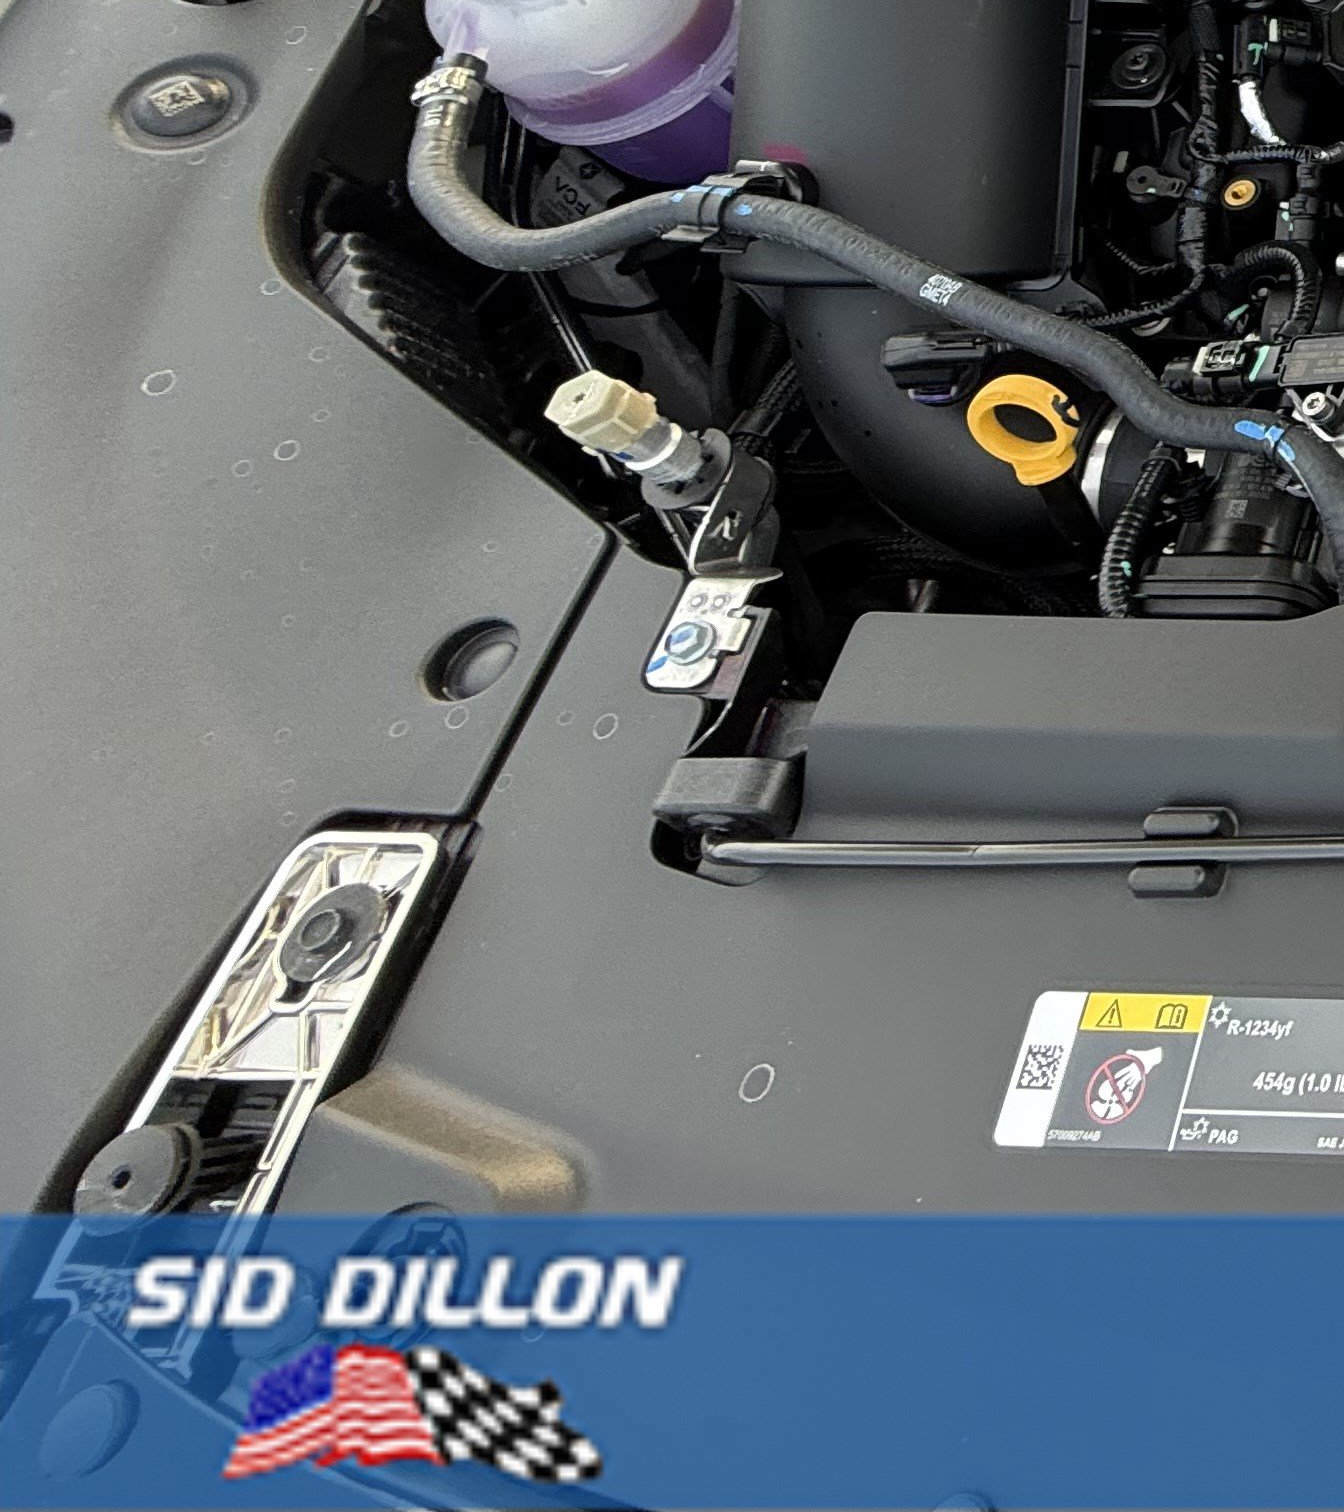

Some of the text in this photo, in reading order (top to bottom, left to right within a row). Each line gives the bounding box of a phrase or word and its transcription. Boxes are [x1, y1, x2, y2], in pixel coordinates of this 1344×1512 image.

[1227, 1019, 1293, 1039] R-1234yf
[1253, 1073, 1294, 1095] 454g
[1298, 1072, 1331, 1096] (1.0
[1208, 1129, 1238, 1145] PAG
[1316, 1136, 1338, 1148] SAE
